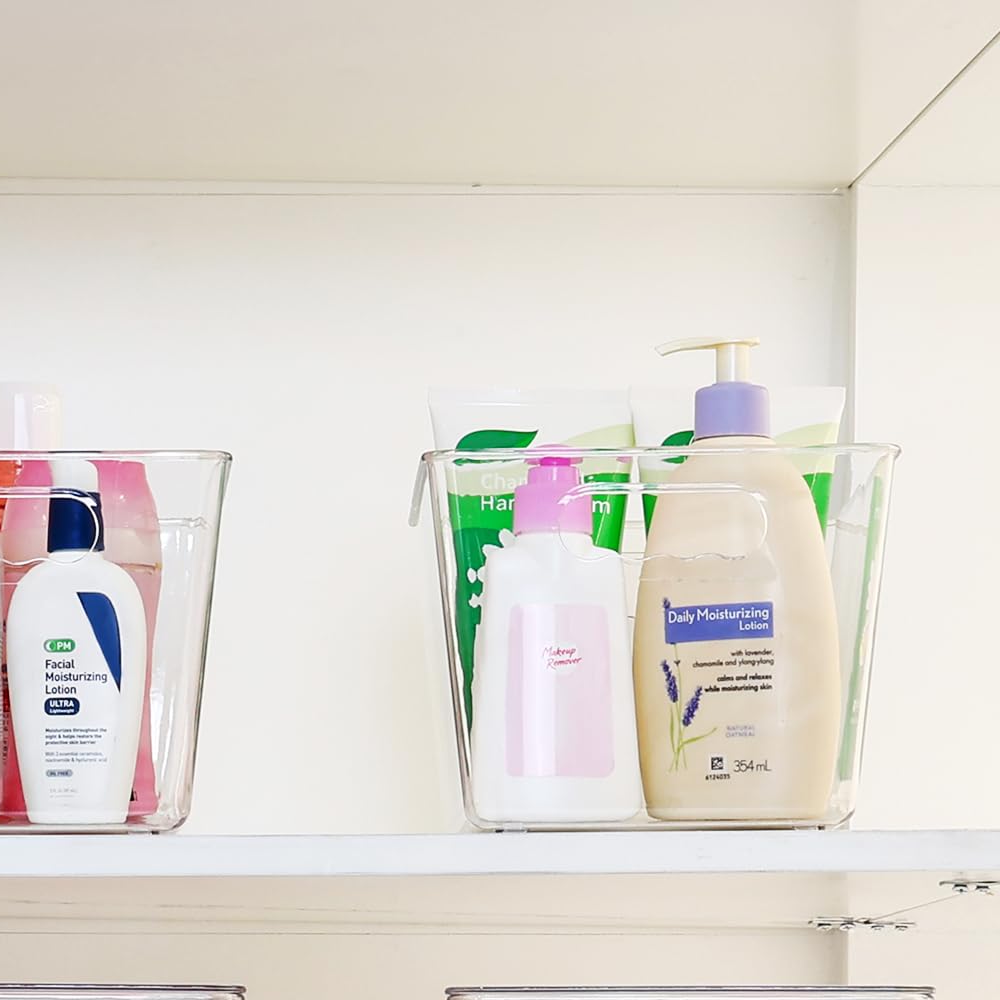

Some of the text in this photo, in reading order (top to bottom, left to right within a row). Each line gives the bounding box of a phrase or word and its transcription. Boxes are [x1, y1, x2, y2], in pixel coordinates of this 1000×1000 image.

[668, 608, 769, 624] Daily Moisturizing
[739, 621, 769, 631] Lotion
[543, 646, 577, 658] Makeup
[45, 659, 75, 669] Facial
[546, 657, 582, 670] Remover
[692, 660, 723, 668] chamomile
[45, 672, 108, 683] Moisturizing
[717, 674, 734, 682] calms
[45, 685, 77, 695] Lotion
[721, 684, 758, 692] moisturizing
[760, 682, 772, 690] skin
[733, 760, 772, 773] 354 mL
